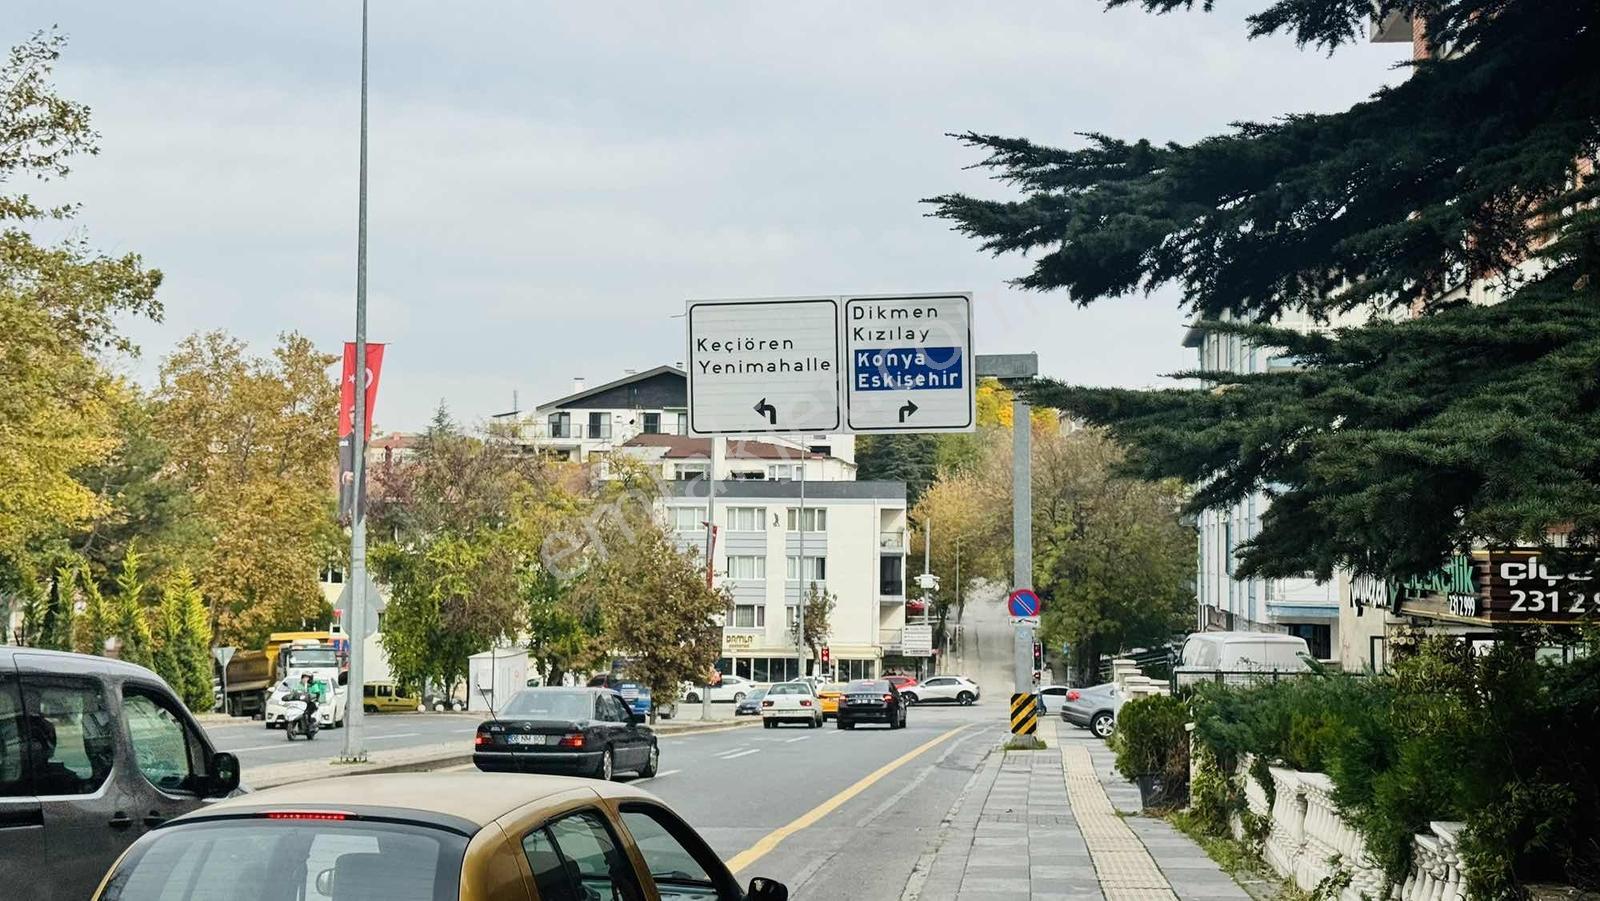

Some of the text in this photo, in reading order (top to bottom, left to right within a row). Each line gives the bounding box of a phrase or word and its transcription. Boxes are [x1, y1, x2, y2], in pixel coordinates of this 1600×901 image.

[853, 306, 938, 320] Dikmen
[853, 326, 930, 343] Kızılay
[696, 337, 794, 354] Keçiören
[698, 357, 831, 375] Yenimahalle
[857, 351, 926, 369] Konya
[857, 370, 959, 390] Eskişehir
[1509, 589, 1559, 613] 231
